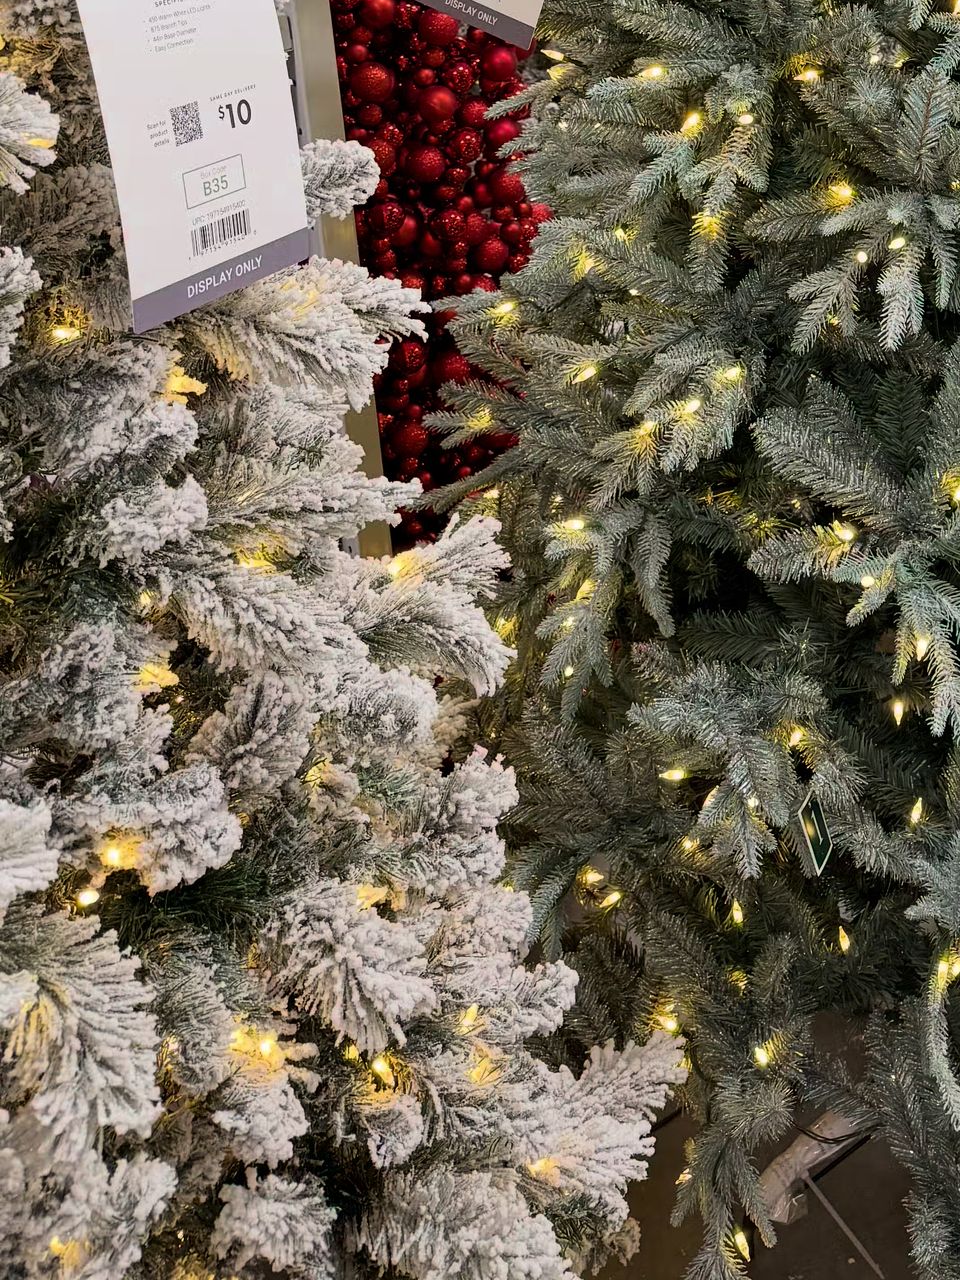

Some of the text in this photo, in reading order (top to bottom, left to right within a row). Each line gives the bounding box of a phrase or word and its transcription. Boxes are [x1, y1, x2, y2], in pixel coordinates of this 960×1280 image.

[477, 11, 499, 26] ONLY
[218, 99, 251, 129] $10
[203, 174, 229, 197] B35
[187, 255, 262, 298] DISPLAY ONLY
